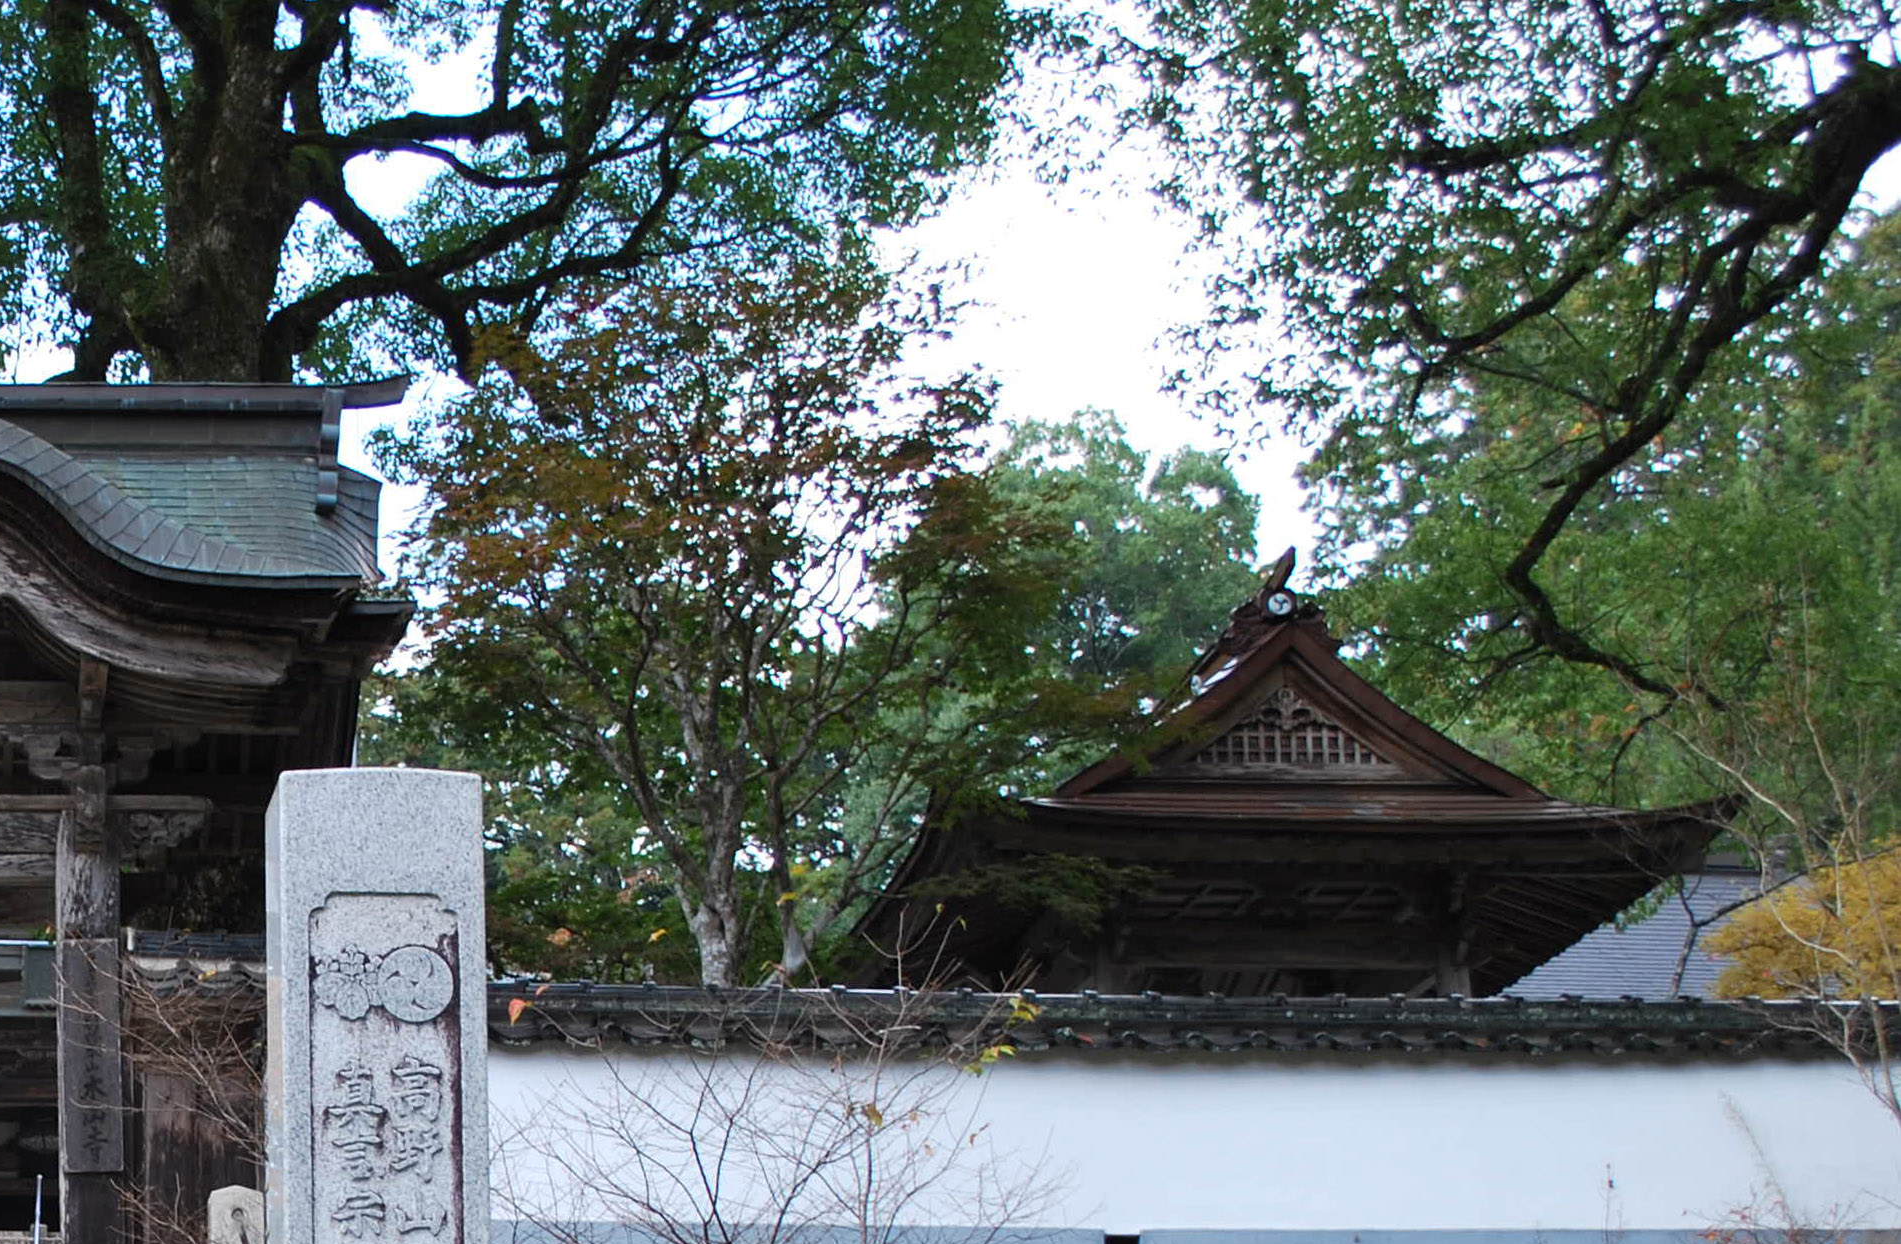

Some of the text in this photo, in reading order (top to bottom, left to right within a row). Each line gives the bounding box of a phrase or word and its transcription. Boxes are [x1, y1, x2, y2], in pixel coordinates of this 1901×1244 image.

[325, 1058, 388, 1239] 真言宗
[389, 1054, 448, 1238] 高野山
